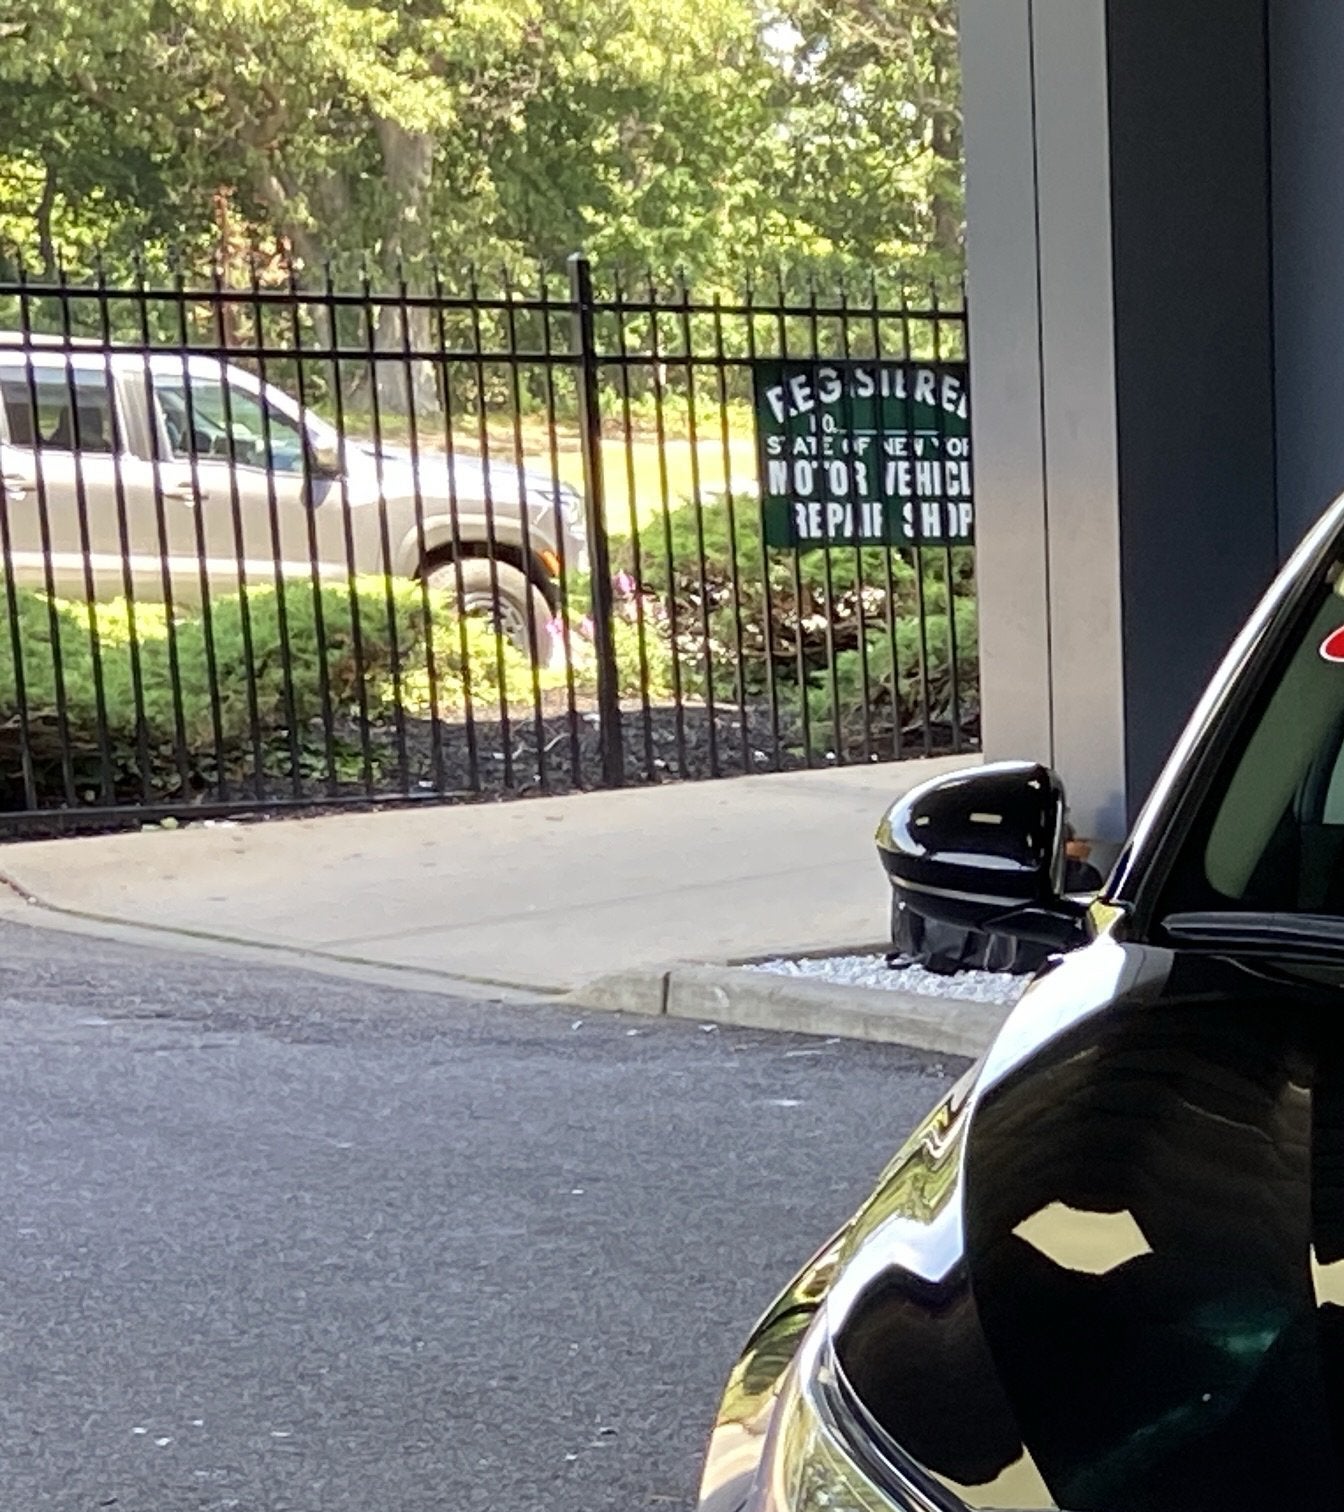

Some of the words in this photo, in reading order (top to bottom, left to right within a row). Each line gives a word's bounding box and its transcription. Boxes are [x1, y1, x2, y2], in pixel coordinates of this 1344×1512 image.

[766, 367, 967, 424] REGSERE
[767, 436, 834, 455] SATE
[768, 459, 868, 496] MOOR
